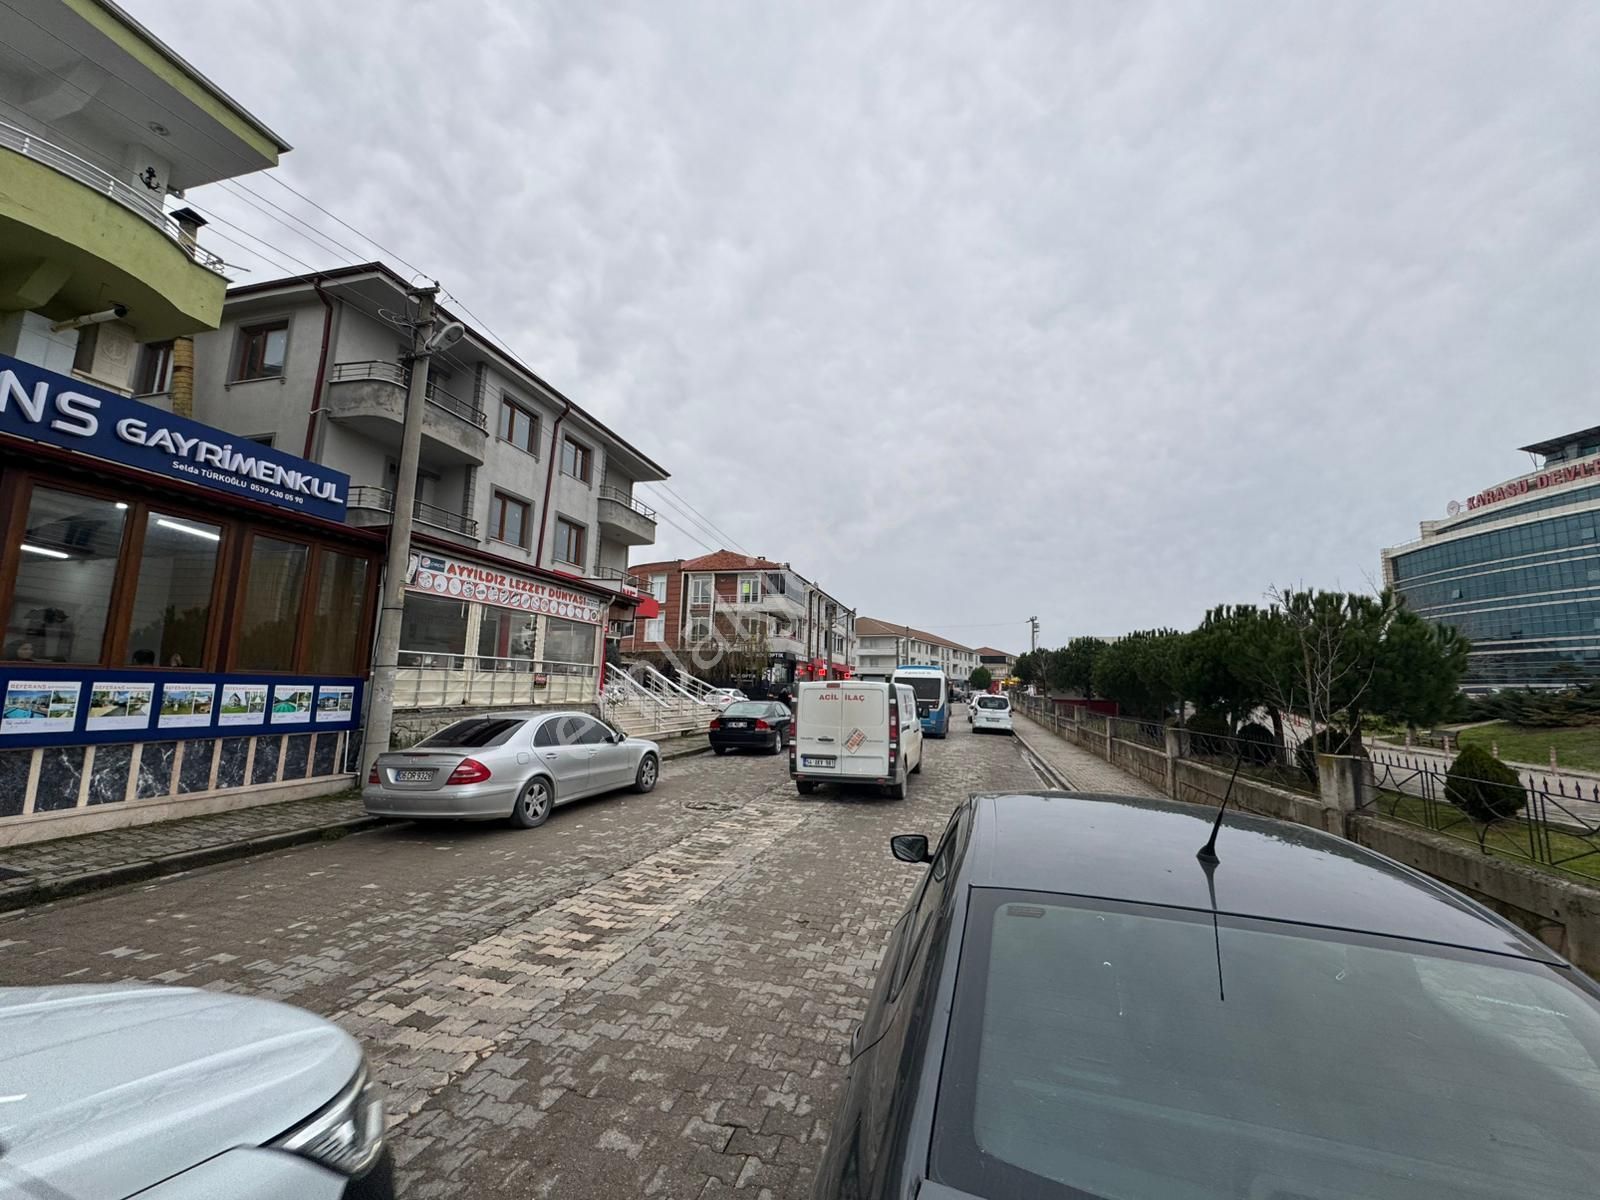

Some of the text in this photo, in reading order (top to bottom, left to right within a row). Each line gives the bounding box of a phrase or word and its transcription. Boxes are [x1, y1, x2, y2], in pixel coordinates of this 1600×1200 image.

[115, 417, 344, 504] GAYRİMENKUL
[172, 460, 304, 504] Selda TÜRKOĞLU 0539 430 05 90
[1466, 478, 1529, 511] KARASU
[447, 562, 506, 587] AYYILDIZ
[508, 577, 547, 597] LEZZET
[548, 586, 586, 606] DÜNYASI
[819, 693, 865, 703] ACİL İLAÇ
